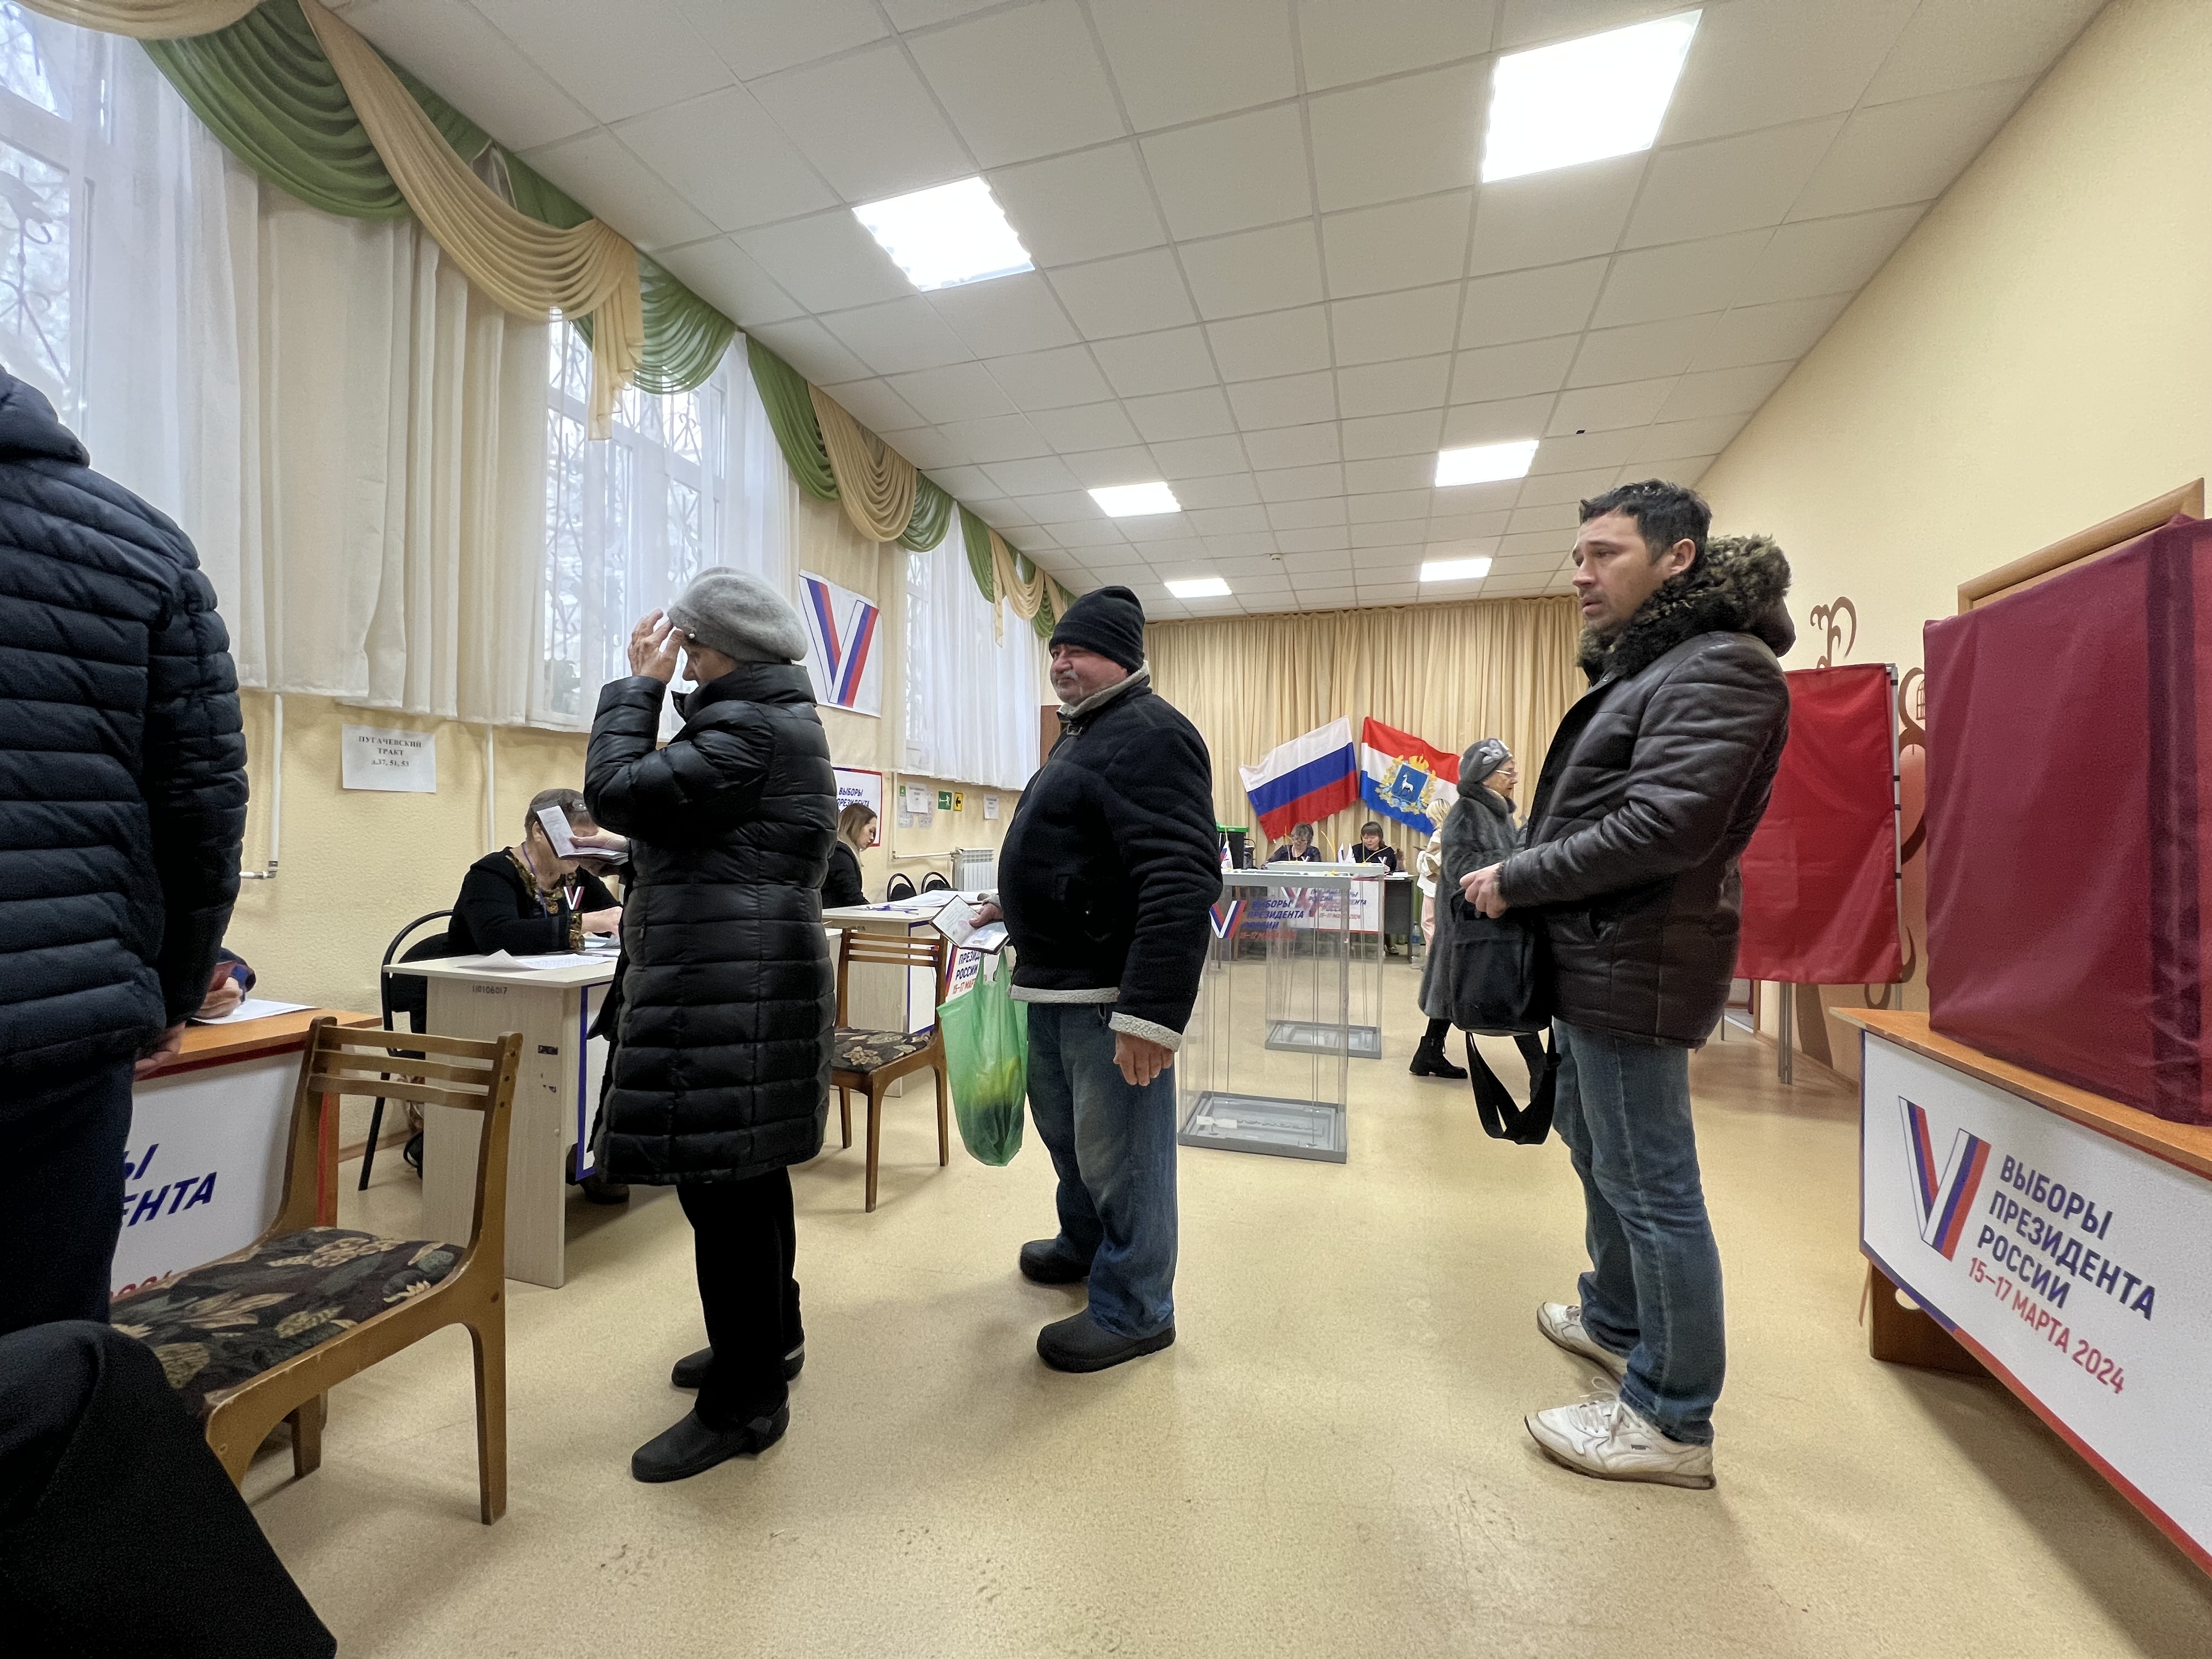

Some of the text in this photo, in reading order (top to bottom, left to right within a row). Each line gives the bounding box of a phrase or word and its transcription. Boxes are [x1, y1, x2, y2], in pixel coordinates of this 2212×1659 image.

[359, 736, 421, 748] ПУГАЧЕВСКИЙ
[377, 747, 404, 755] ТРАКТ
[839, 787, 863, 797] ВЫБОРЫ
[1248, 911, 1304, 919] ПРЕЗИДЕНТА
[958, 950, 981, 966] ПРЕЗИД
[955, 964, 979, 981] РОССИИ
[2000, 1154, 2113, 1240] ВЫБОРЫ
[1989, 1190, 2156, 1321] ПРЕЗИДЕНТА
[1977, 1224, 2072, 1309] РОССИИ
[2012, 1289, 2072, 1354] МАРТА
[2072, 1339, 2125, 1395] 2024
